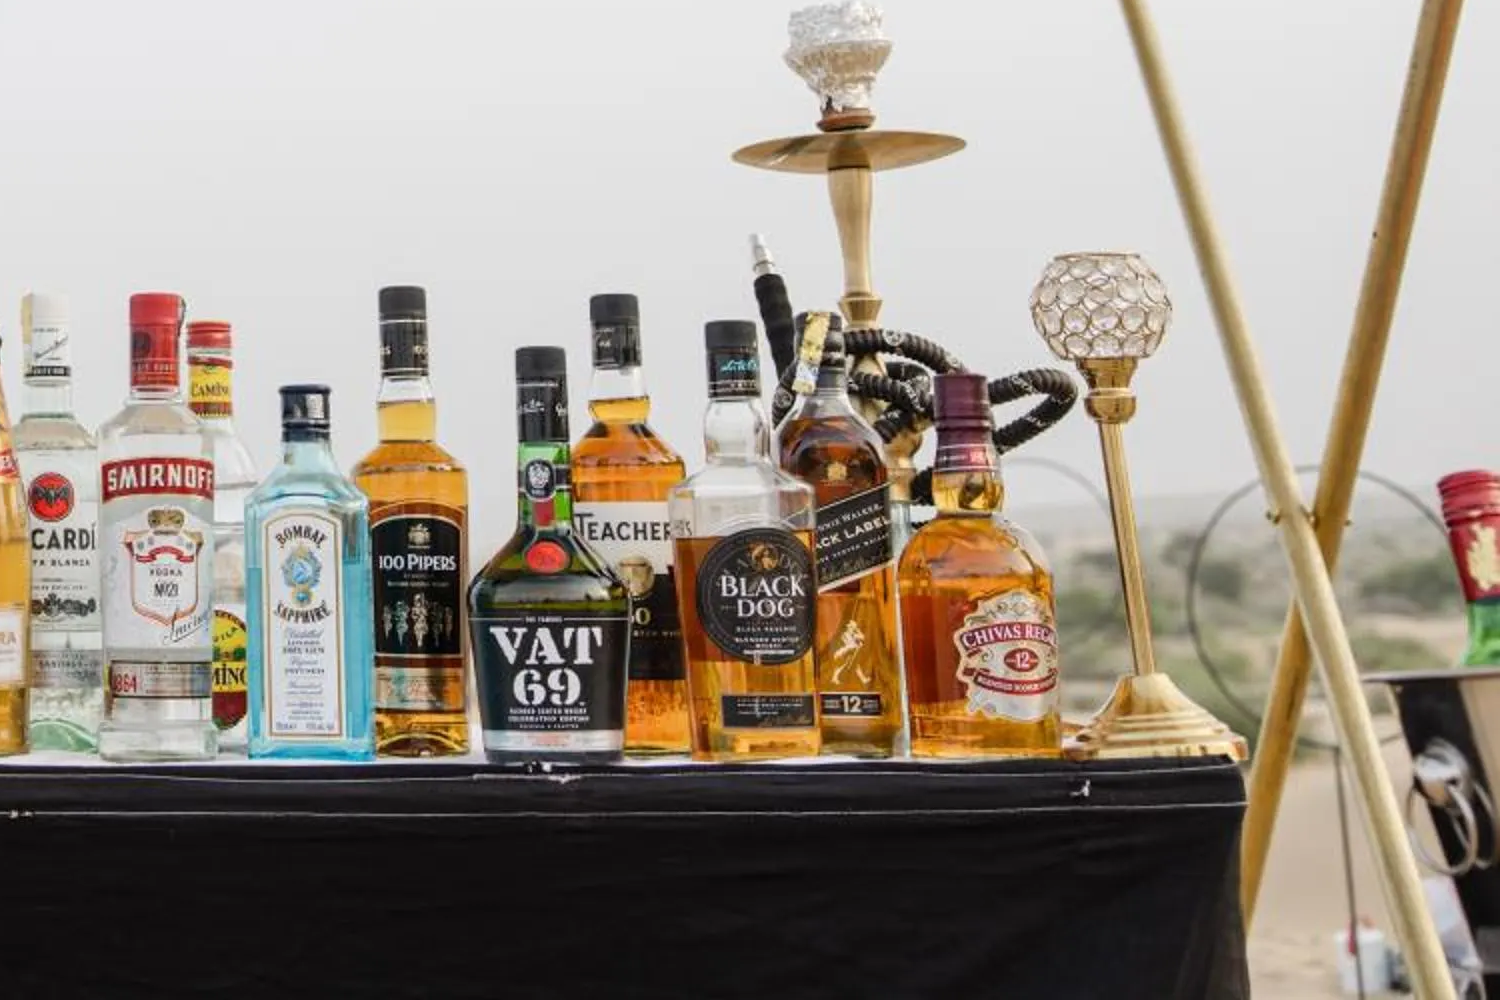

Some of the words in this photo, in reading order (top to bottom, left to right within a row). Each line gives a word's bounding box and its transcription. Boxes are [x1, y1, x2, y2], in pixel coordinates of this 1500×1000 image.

[31, 522, 96, 551] CARDÍ
[275, 525, 327, 548] BOMBAY
[843, 515, 891, 539] LABEL
[379, 555, 405, 570] 100
[407, 553, 457, 571] PIPERS
[721, 575, 805, 597] BLACK
[737, 599, 795, 618] DOG
[489, 626, 603, 665] VAT
[963, 623, 1021, 647] CHIVAS
[1014, 650, 1031, 669] 12
[513, 668, 581, 706] 69
[840, 695, 863, 713] 12
